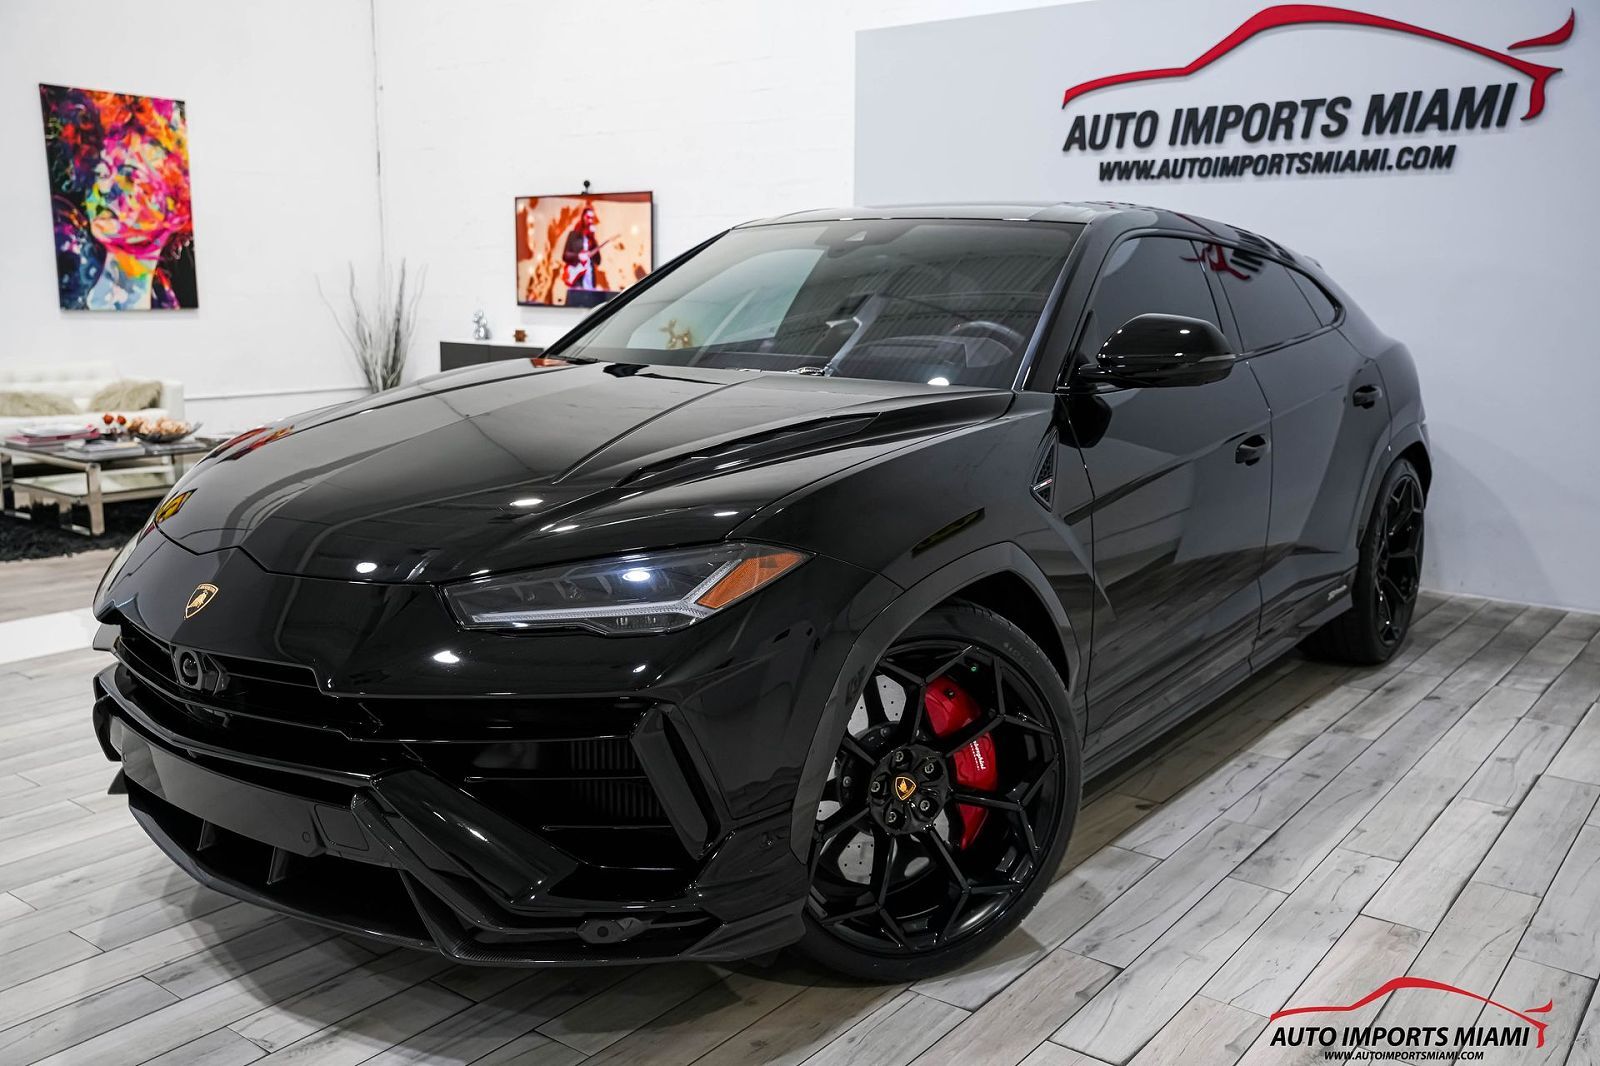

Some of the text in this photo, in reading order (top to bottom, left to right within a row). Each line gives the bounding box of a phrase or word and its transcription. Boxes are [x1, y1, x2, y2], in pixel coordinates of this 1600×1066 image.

[1063, 82, 1518, 152] AUTO IMPORTS MIAMI
[1099, 145, 1456, 182] WWW.AUTOIMPORTSMIAMI.COM
